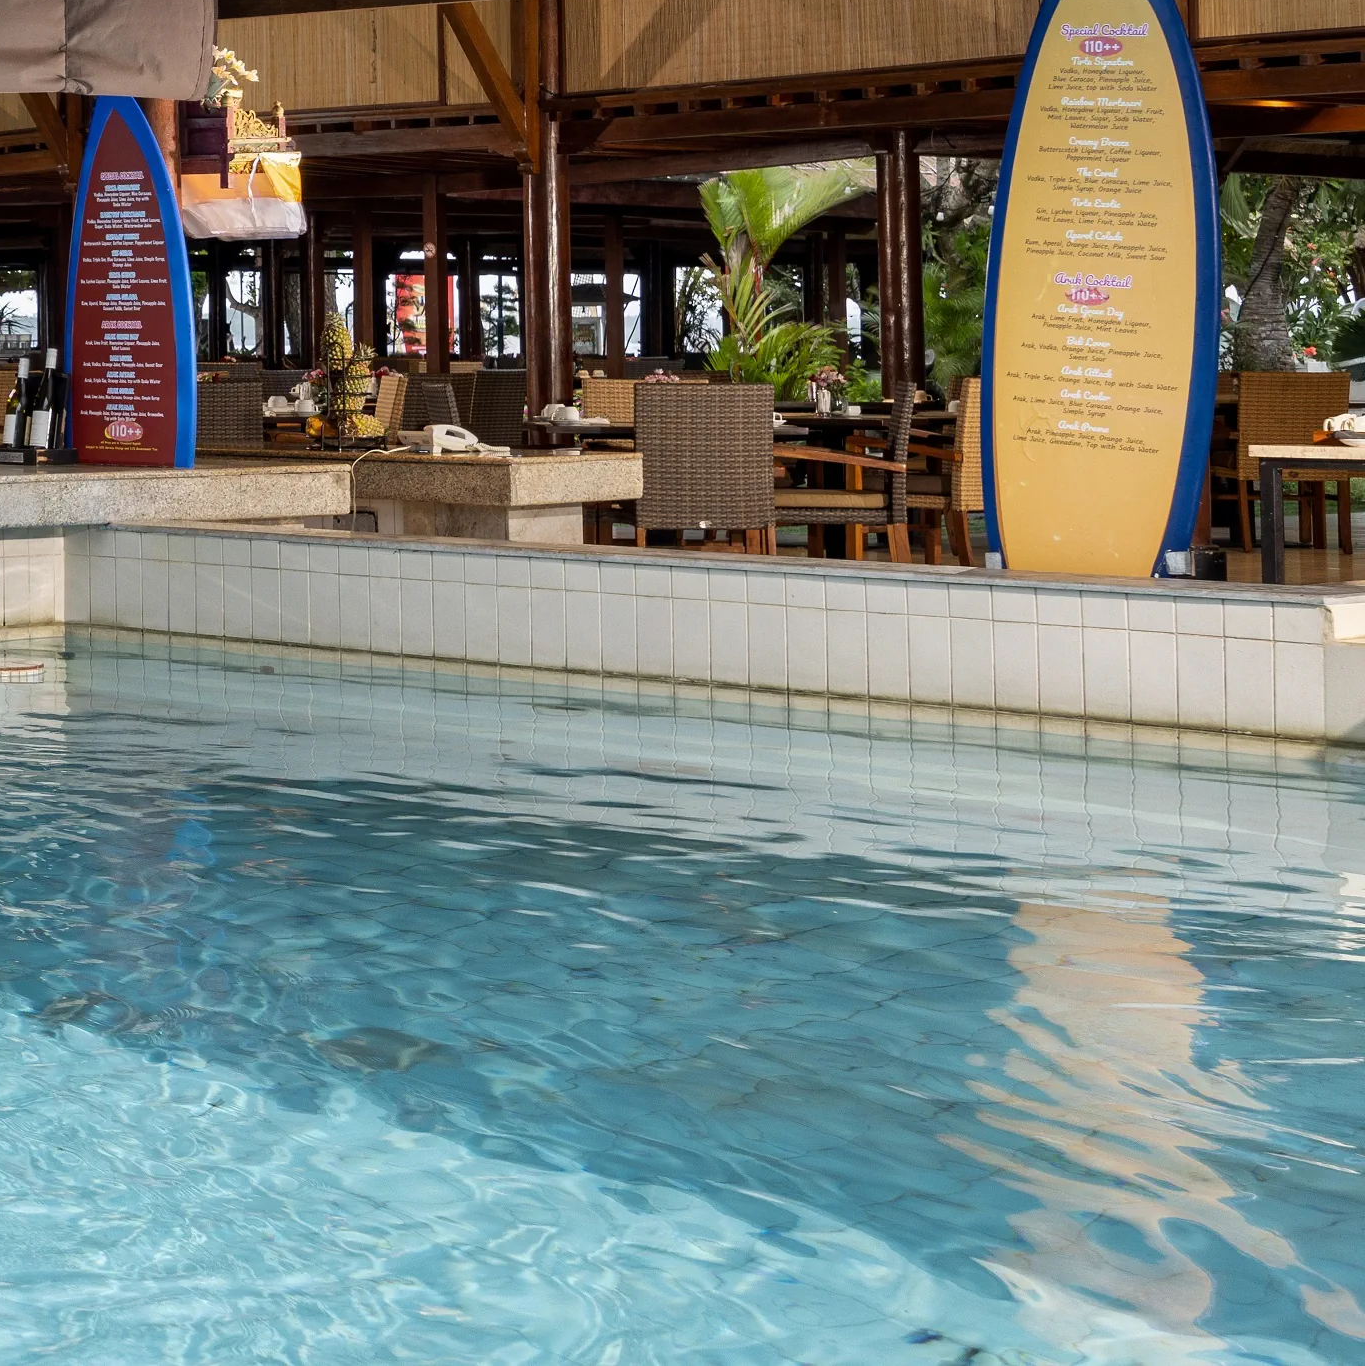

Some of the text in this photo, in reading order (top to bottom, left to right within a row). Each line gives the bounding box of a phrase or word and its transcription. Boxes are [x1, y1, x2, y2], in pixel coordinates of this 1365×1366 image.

[1061, 23, 1149, 41] Special Cocktail
[1085, 40, 1120, 53] 110++
[1054, 272, 1132, 288] Arak Cocktail
[111, 425, 141, 437] 110++
